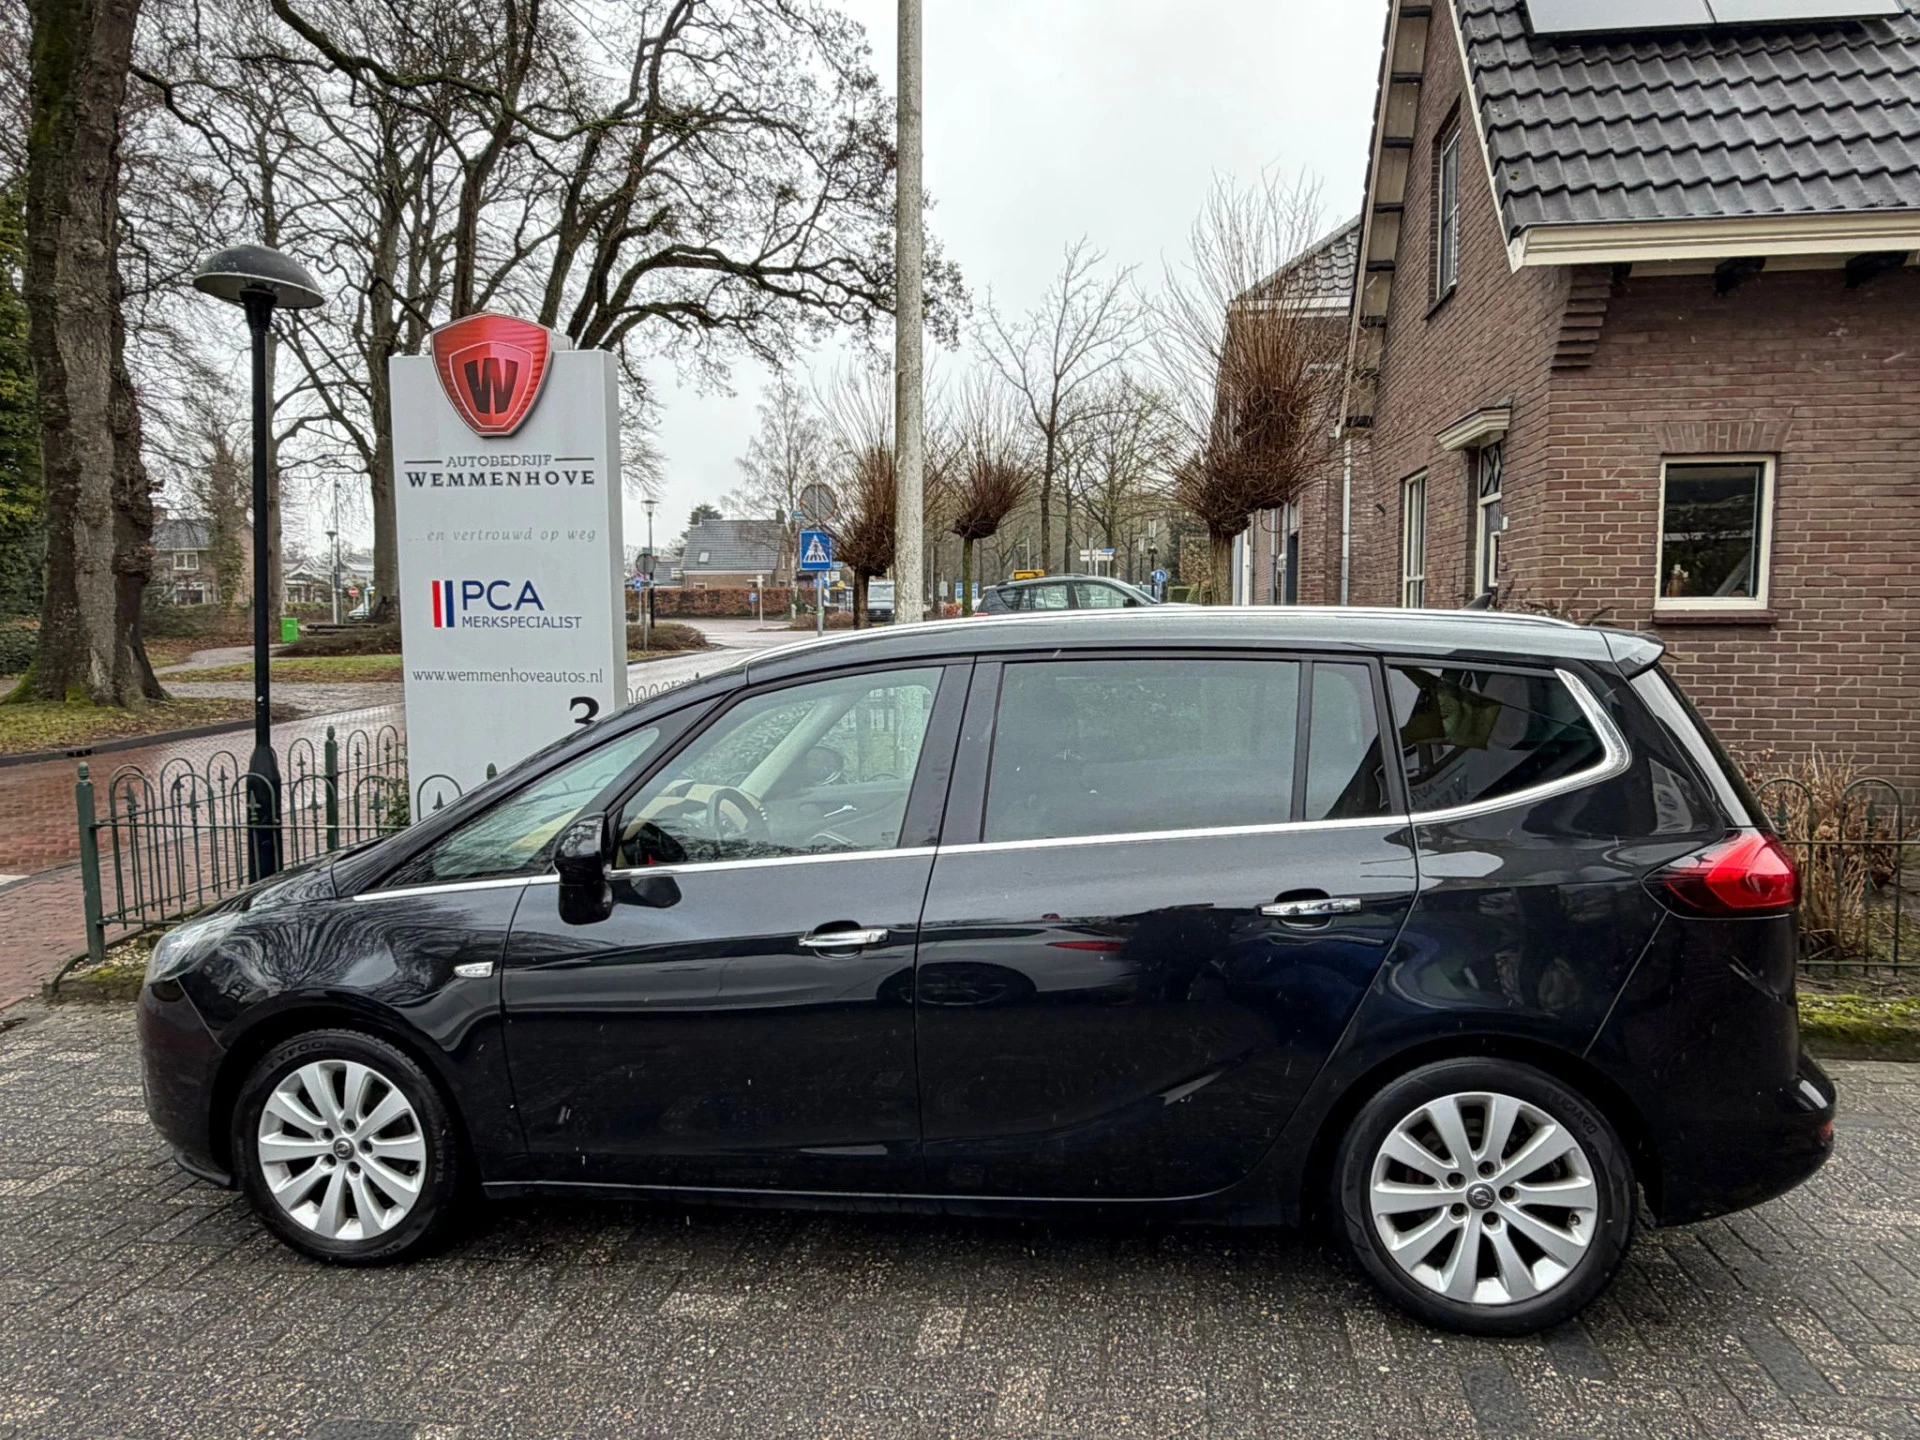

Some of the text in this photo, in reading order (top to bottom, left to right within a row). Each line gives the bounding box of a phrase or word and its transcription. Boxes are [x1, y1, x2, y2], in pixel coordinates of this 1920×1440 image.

[464, 357, 519, 414] W
[445, 454, 552, 468] AUTOBEDRIJF
[405, 470, 595, 488] WEMMENHOVE
[453, 527, 533, 541] vertrouwd
[540, 530, 559, 543] op
[568, 529, 596, 543] weg
[461, 580, 545, 611] PCA
[462, 615, 582, 629] MERKSPECIALIST
[412, 668, 603, 684] www.wemmenhoveautos.nl
